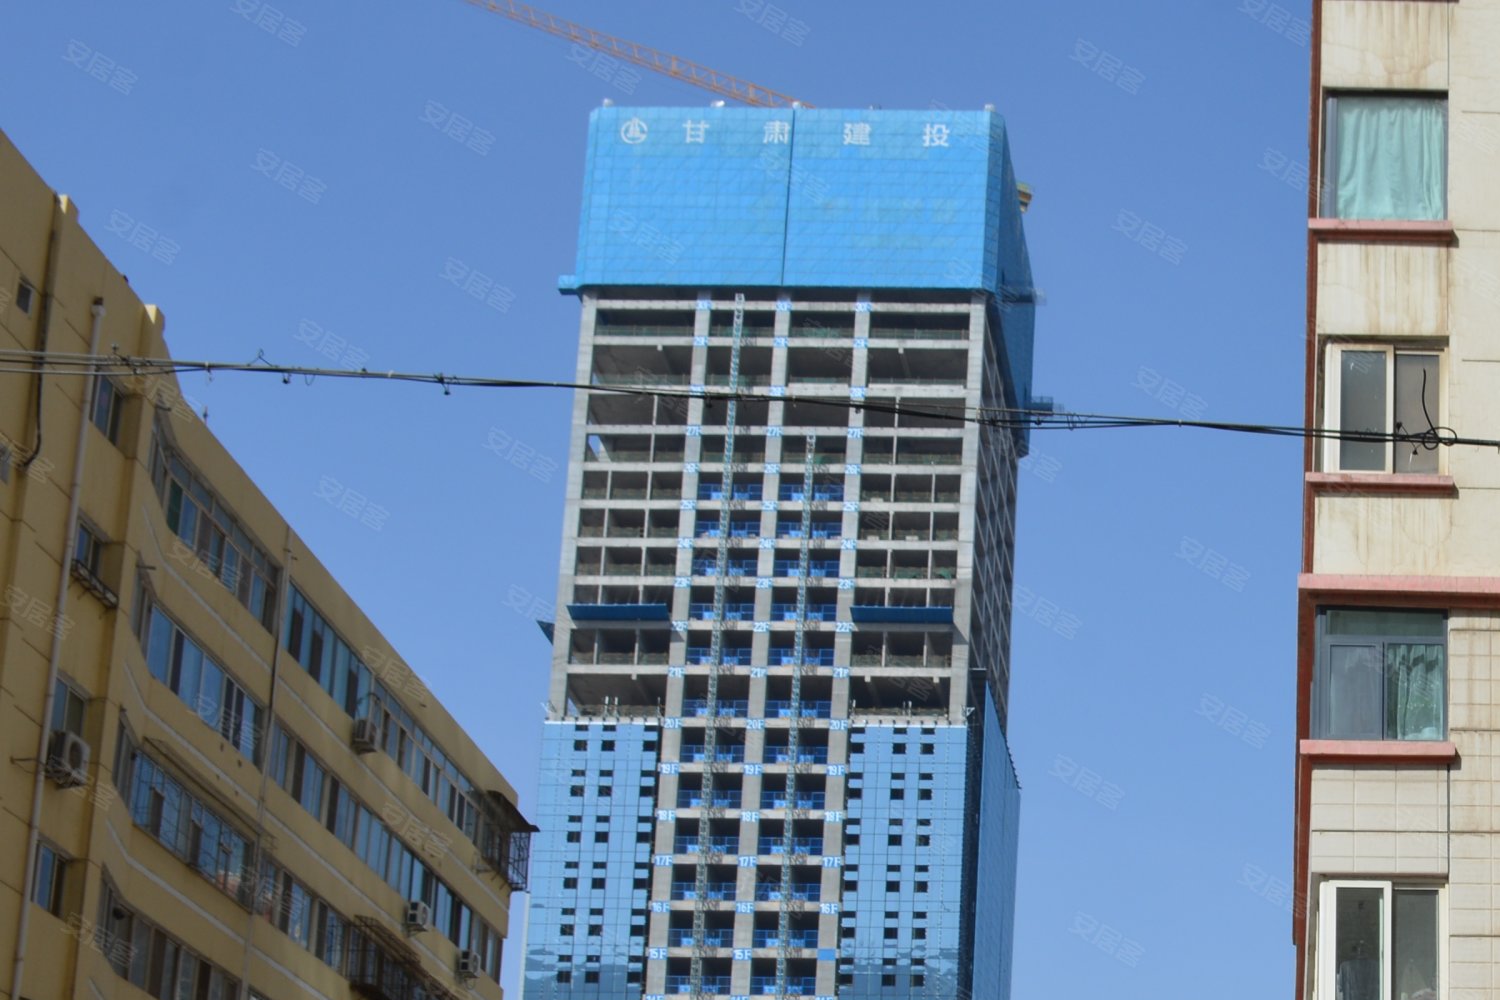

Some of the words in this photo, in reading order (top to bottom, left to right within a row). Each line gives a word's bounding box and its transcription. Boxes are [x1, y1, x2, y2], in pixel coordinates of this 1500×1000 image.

[683, 120, 949, 147] 甘肃建投
[688, 426, 700, 435] 27F
[768, 427, 781, 436] 27F
[849, 428, 862, 437] 27F
[678, 538, 692, 548] 24F
[760, 539, 775, 548] 24F
[841, 539, 856, 548] 24F
[676, 577, 690, 586] 23F
[757, 578, 772, 587] 23F
[838, 578, 853, 587] 23F
[754, 622, 769, 632] 22F
[836, 622, 851, 632] 22F
[669, 668, 683, 676] 21F
[752, 668, 766, 676] 21F
[834, 668, 848, 678] 21F
[665, 719, 681, 728] 20F
[747, 720, 764, 729] 20F
[830, 720, 847, 729] 20F
[661, 764, 678, 773] 19F
[744, 765, 762, 774] 19F
[828, 766, 845, 775] 19F
[658, 811, 674, 821] 18F
[742, 812, 759, 821] 18F
[826, 812, 842, 822] 18F
[655, 856, 672, 865] 17F
[739, 857, 756, 866] 17F
[824, 857, 841, 866] 17F
[653, 903, 669, 912] 16F
[737, 903, 754, 912] 16F
[821, 904, 838, 913] 16F
[649, 949, 666, 958] 15F
[734, 949, 752, 958] 15F
